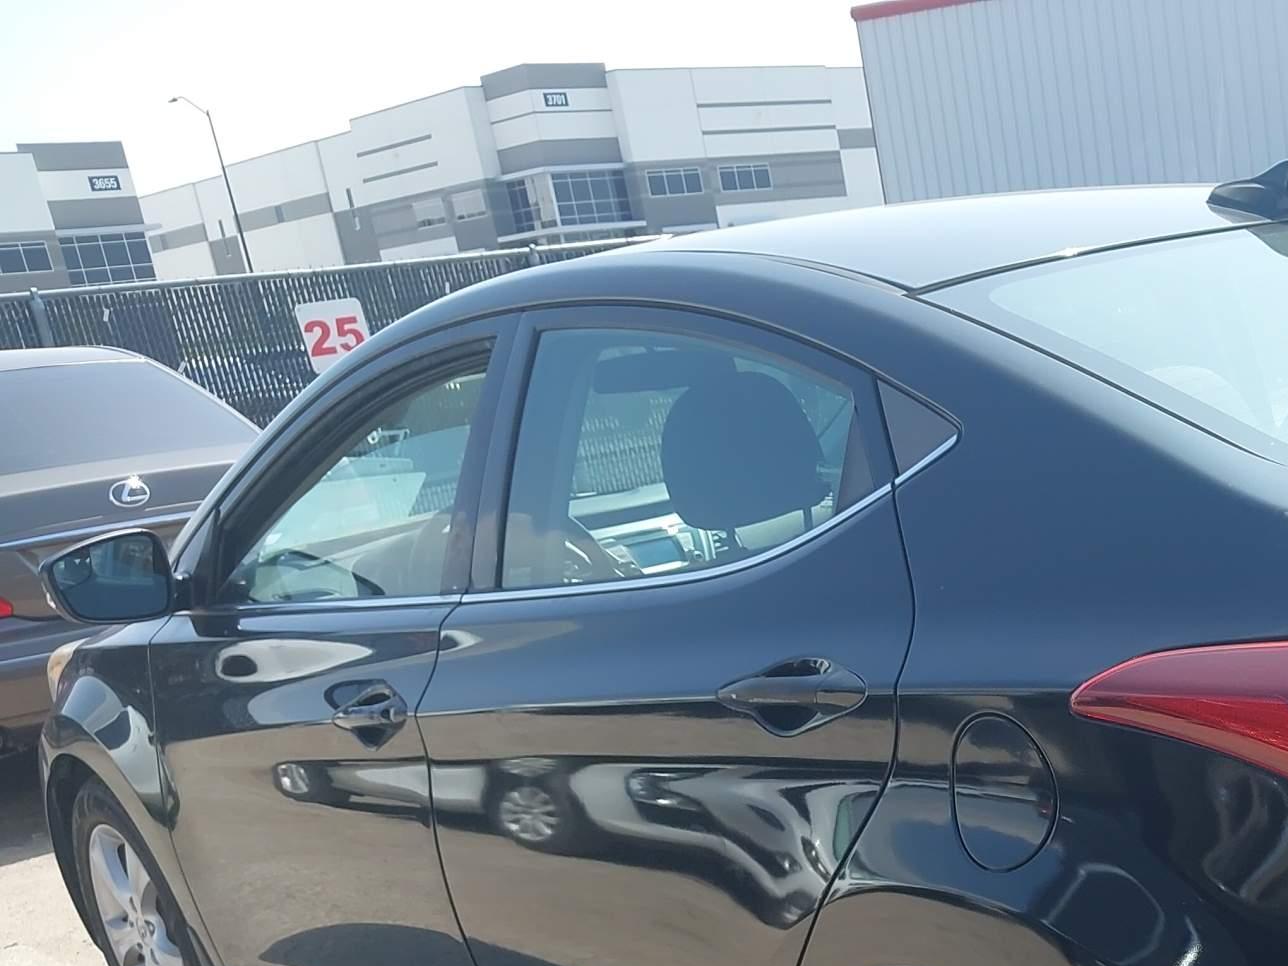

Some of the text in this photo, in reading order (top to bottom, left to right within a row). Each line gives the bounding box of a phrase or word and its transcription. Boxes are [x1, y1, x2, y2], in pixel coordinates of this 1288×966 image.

[546, 94, 566, 105] 3701
[92, 178, 118, 189] 3655
[303, 316, 365, 357] 25
